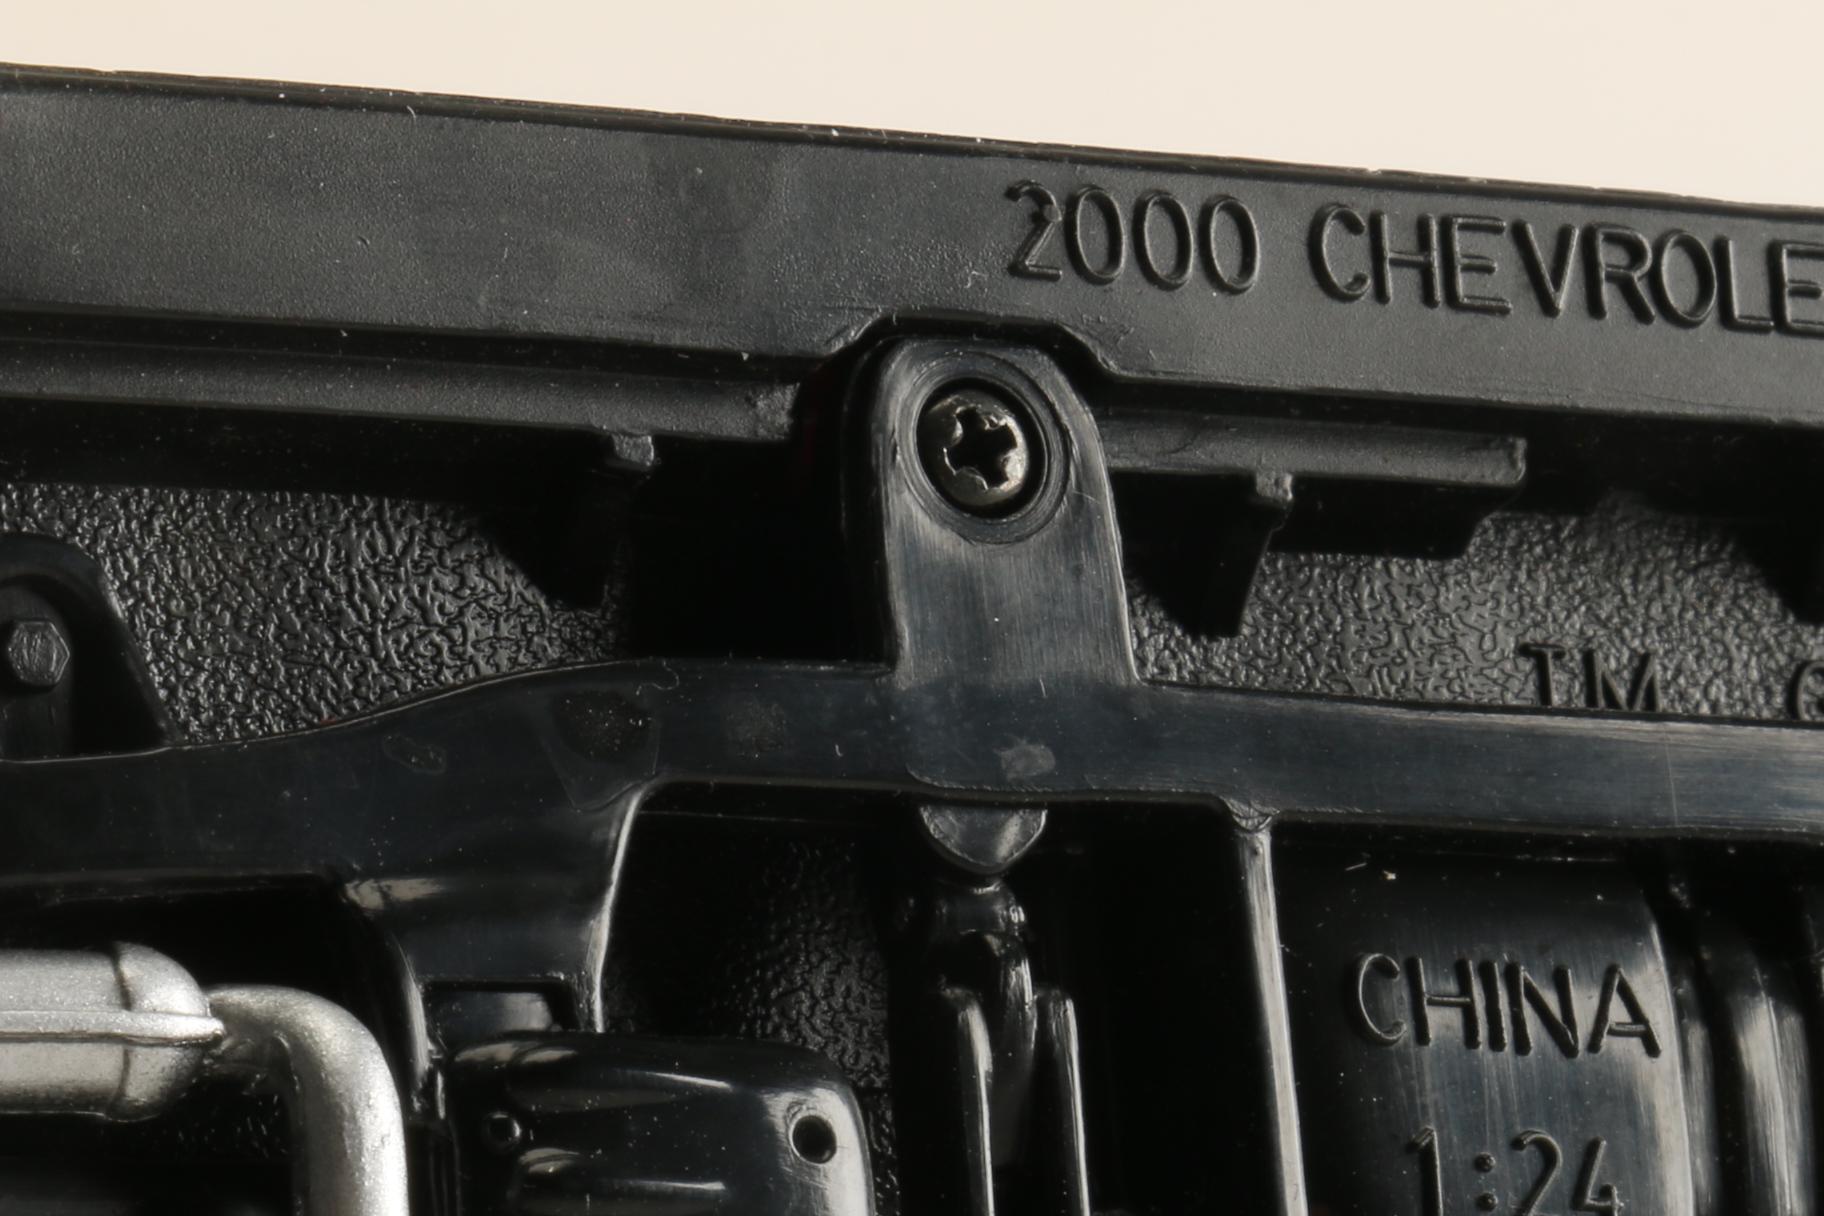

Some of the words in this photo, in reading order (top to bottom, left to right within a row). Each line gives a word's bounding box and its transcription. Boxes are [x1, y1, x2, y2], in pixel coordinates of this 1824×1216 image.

[1004, 178, 1260, 295] 2000
[1517, 641, 1662, 712] TM
[1350, 951, 1663, 1059] CHINA
